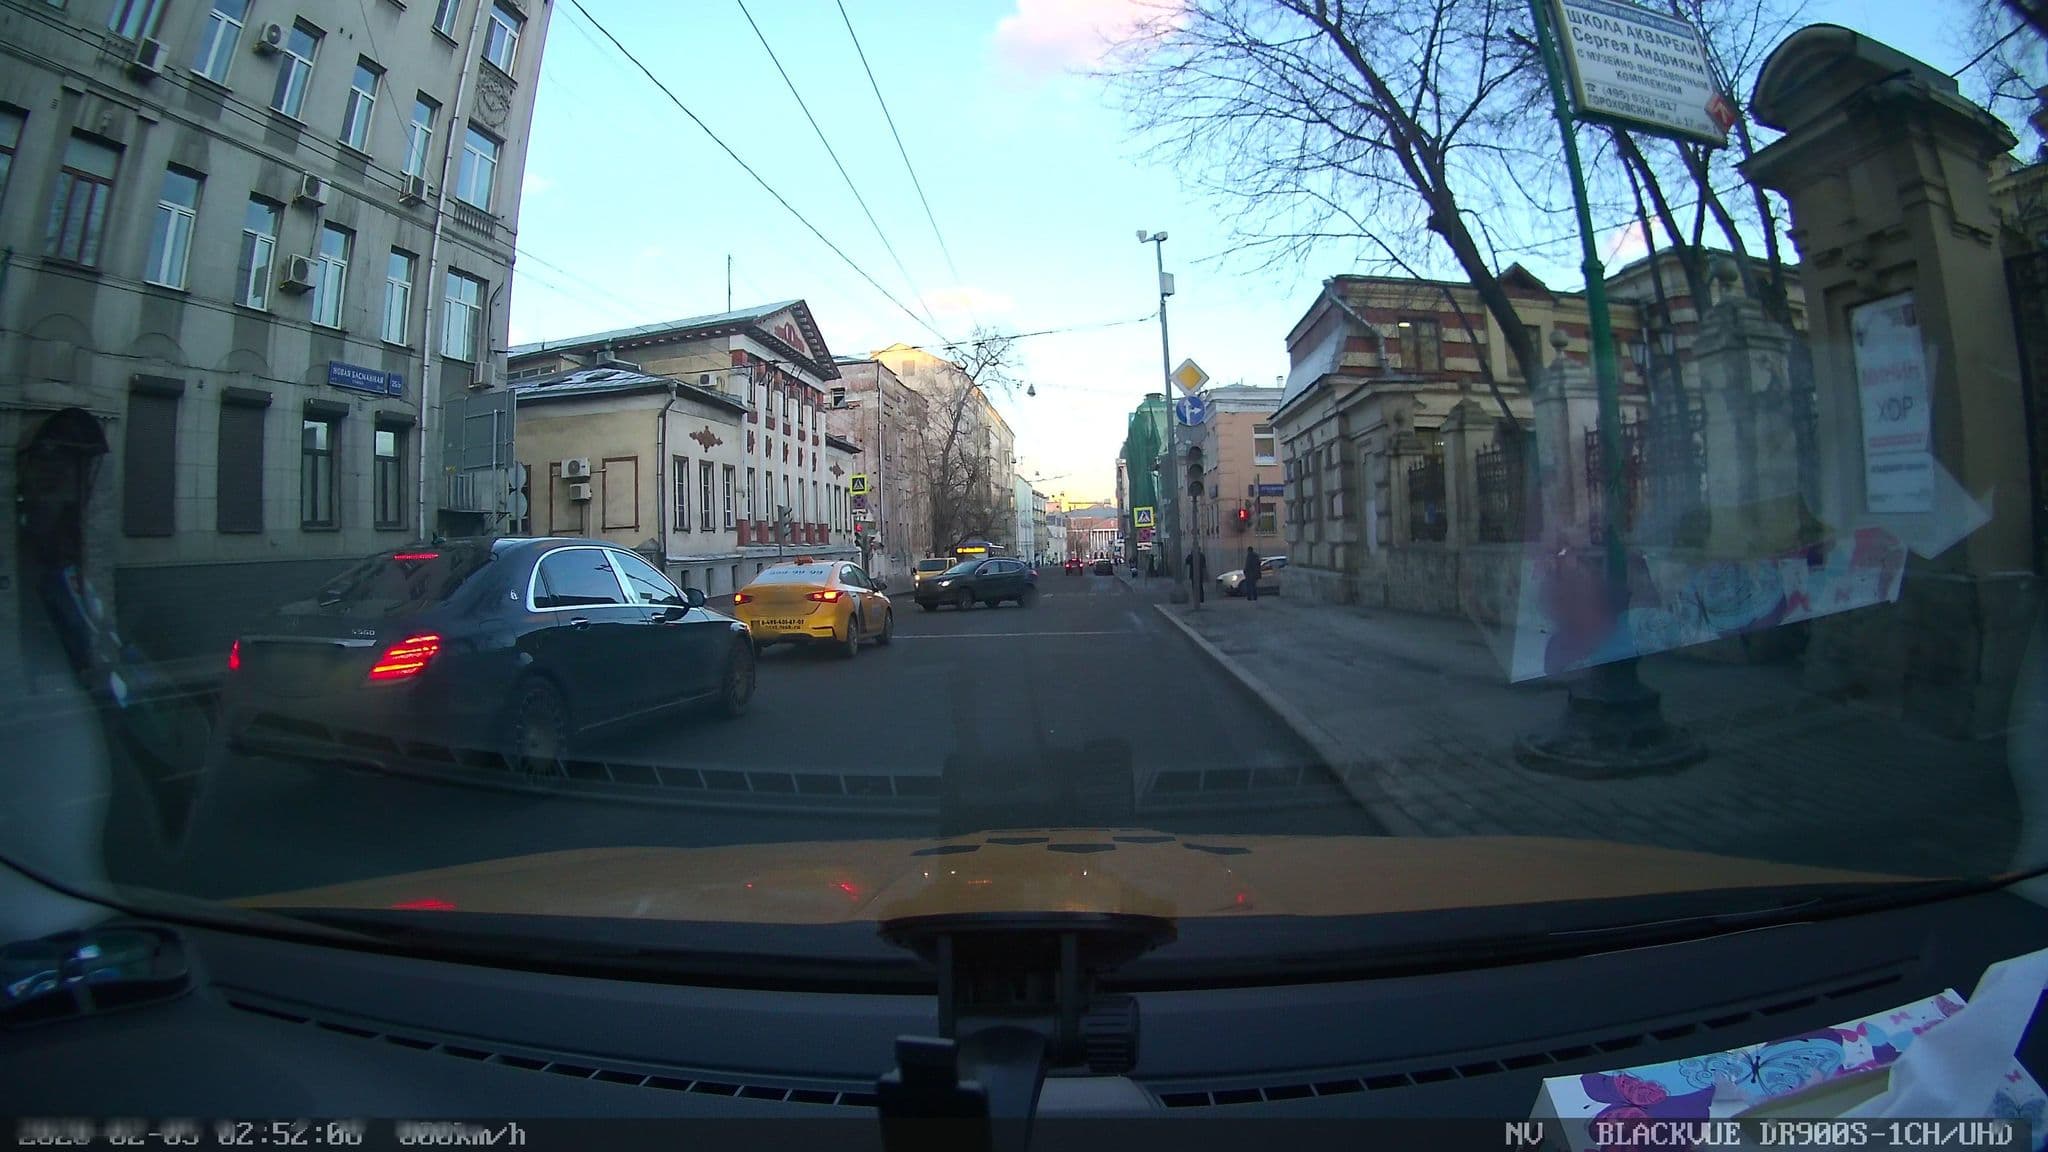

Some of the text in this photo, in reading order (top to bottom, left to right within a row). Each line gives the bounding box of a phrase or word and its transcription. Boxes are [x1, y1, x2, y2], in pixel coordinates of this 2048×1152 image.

[1566, 9, 1624, 36] ШКОЛА
[1626, 25, 1700, 58] АКВАРЕЛИ
[1572, 27, 1706, 75] Сергея Андрияки
[1875, 396, 1914, 423] ХОР
